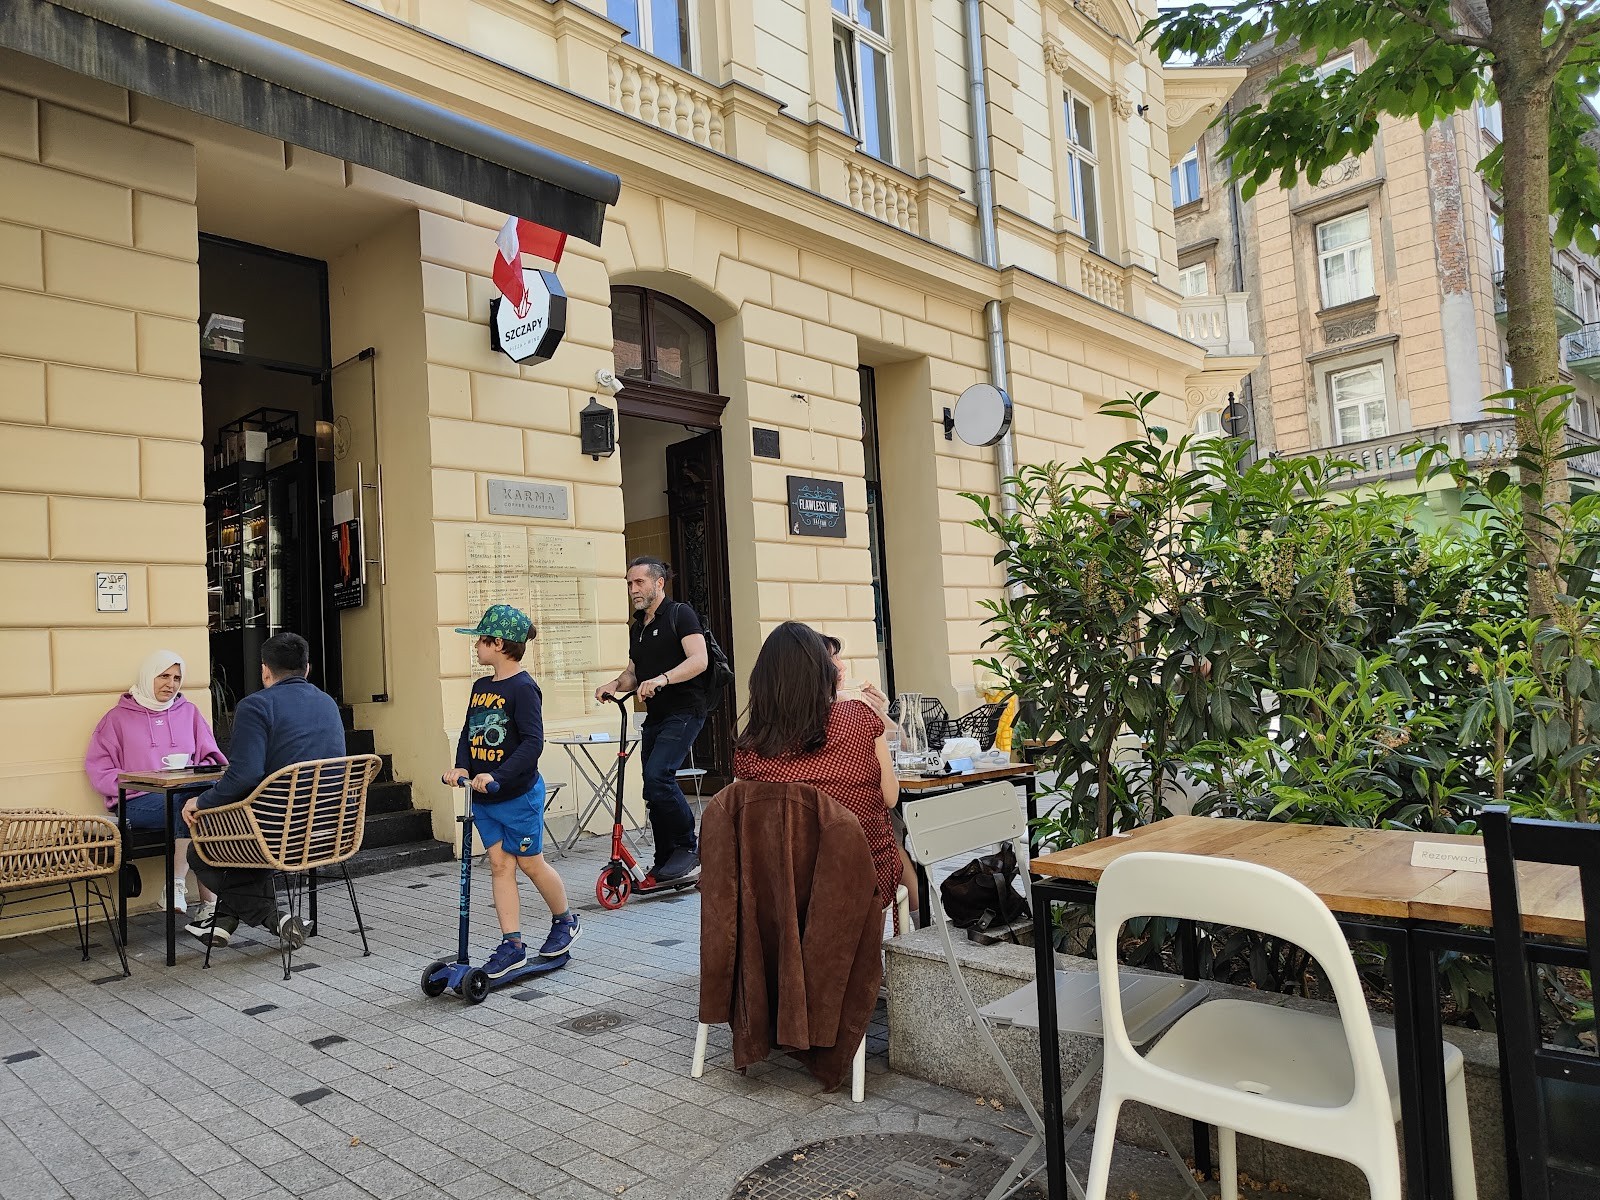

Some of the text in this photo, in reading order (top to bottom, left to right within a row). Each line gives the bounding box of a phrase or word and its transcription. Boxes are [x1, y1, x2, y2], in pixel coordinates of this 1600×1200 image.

[505, 317, 543, 342] SZCZAPY
[503, 488, 555, 503] KARMA
[527, 503, 555, 511] ROASTERS
[799, 498, 838, 513] FLAWLESS LINE
[470, 692, 506, 709] HOW'S
[472, 735, 484, 746] MY
[927, 756, 939, 767] 46
[1421, 850, 1487, 865] Rezerwacja
